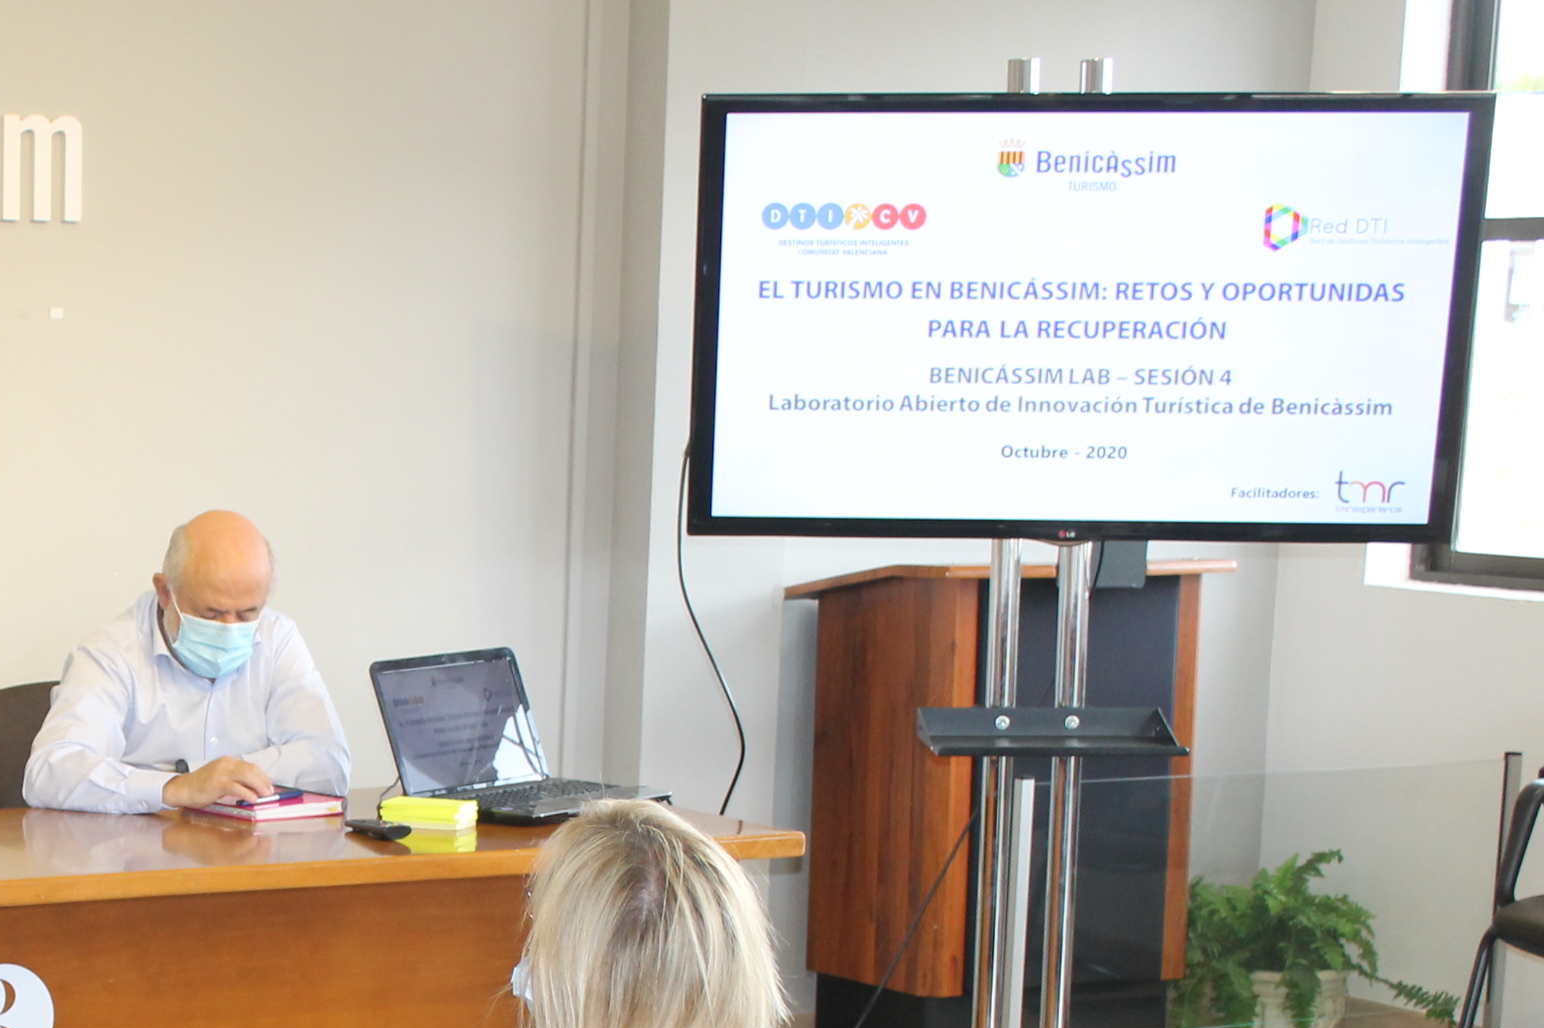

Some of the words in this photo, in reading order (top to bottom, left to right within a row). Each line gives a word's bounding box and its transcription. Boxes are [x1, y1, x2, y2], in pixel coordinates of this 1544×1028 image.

[1068, 180, 1117, 192] TURISMO
[1310, 217, 1348, 234] Red
[1356, 217, 1388, 234] DTI
[778, 238, 814, 247] DESTINOS
[860, 238, 909, 247] INTELIGENTES
[842, 248, 888, 256] VALENCIANA
[759, 280, 785, 299] EL
[791, 280, 903, 300] TURISMO
[911, 280, 942, 300] EN
[949, 277, 1108, 301] BENICÁSSIM:
[1115, 281, 1193, 301] RETOS
[1201, 282, 1216, 301] Y
[1222, 282, 1405, 302] OPORTUNIDAS
[928, 319, 991, 338] PARA
[1000, 319, 1029, 338] LA
[1037, 317, 1227, 340] RECUPERACIÓN
[929, 363, 1063, 385] BENICÁSSIM
[1069, 367, 1111, 385] LAB
[1134, 365, 1214, 386] SESIÓN
[1219, 369, 1233, 386] 4
[768, 394, 894, 412] Laboratorio
[899, 394, 981, 412] Abierto
[985, 394, 1012, 413] de
[1018, 395, 1138, 414] Innovación
[1142, 396, 1234, 414] Turística
[1239, 396, 1265, 415] de
[1271, 397, 1393, 416] Benicàssim
[1000, 444, 1069, 459] Octubre
[1086, 445, 1128, 460] 2020
[1231, 486, 1320, 499] Facilitadores:
